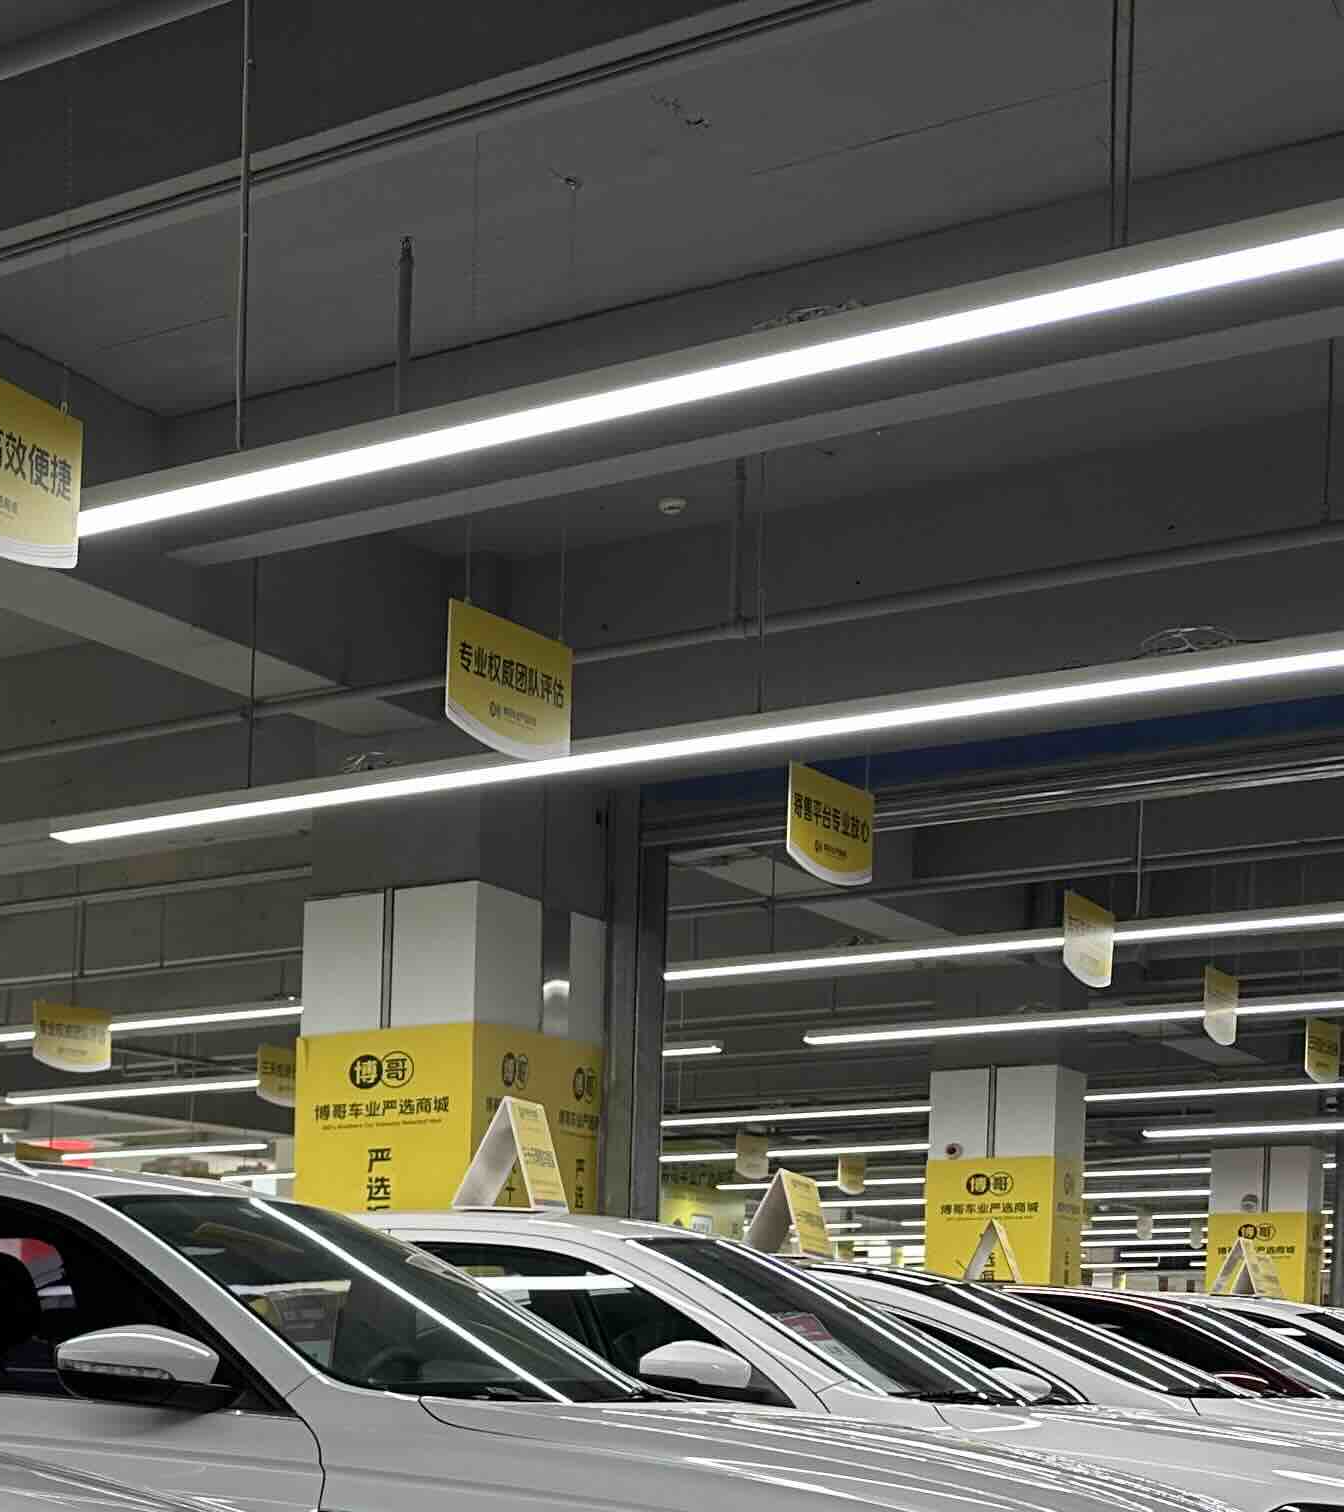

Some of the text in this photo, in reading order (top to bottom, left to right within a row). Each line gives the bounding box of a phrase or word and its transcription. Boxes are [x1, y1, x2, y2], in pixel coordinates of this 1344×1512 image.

[458, 640, 565, 709] 专业权威团队评估
[353, 1055, 411, 1086] 博哥
[314, 1096, 449, 1121] 博哥车业严选商城
[367, 1147, 392, 1211] 严选
